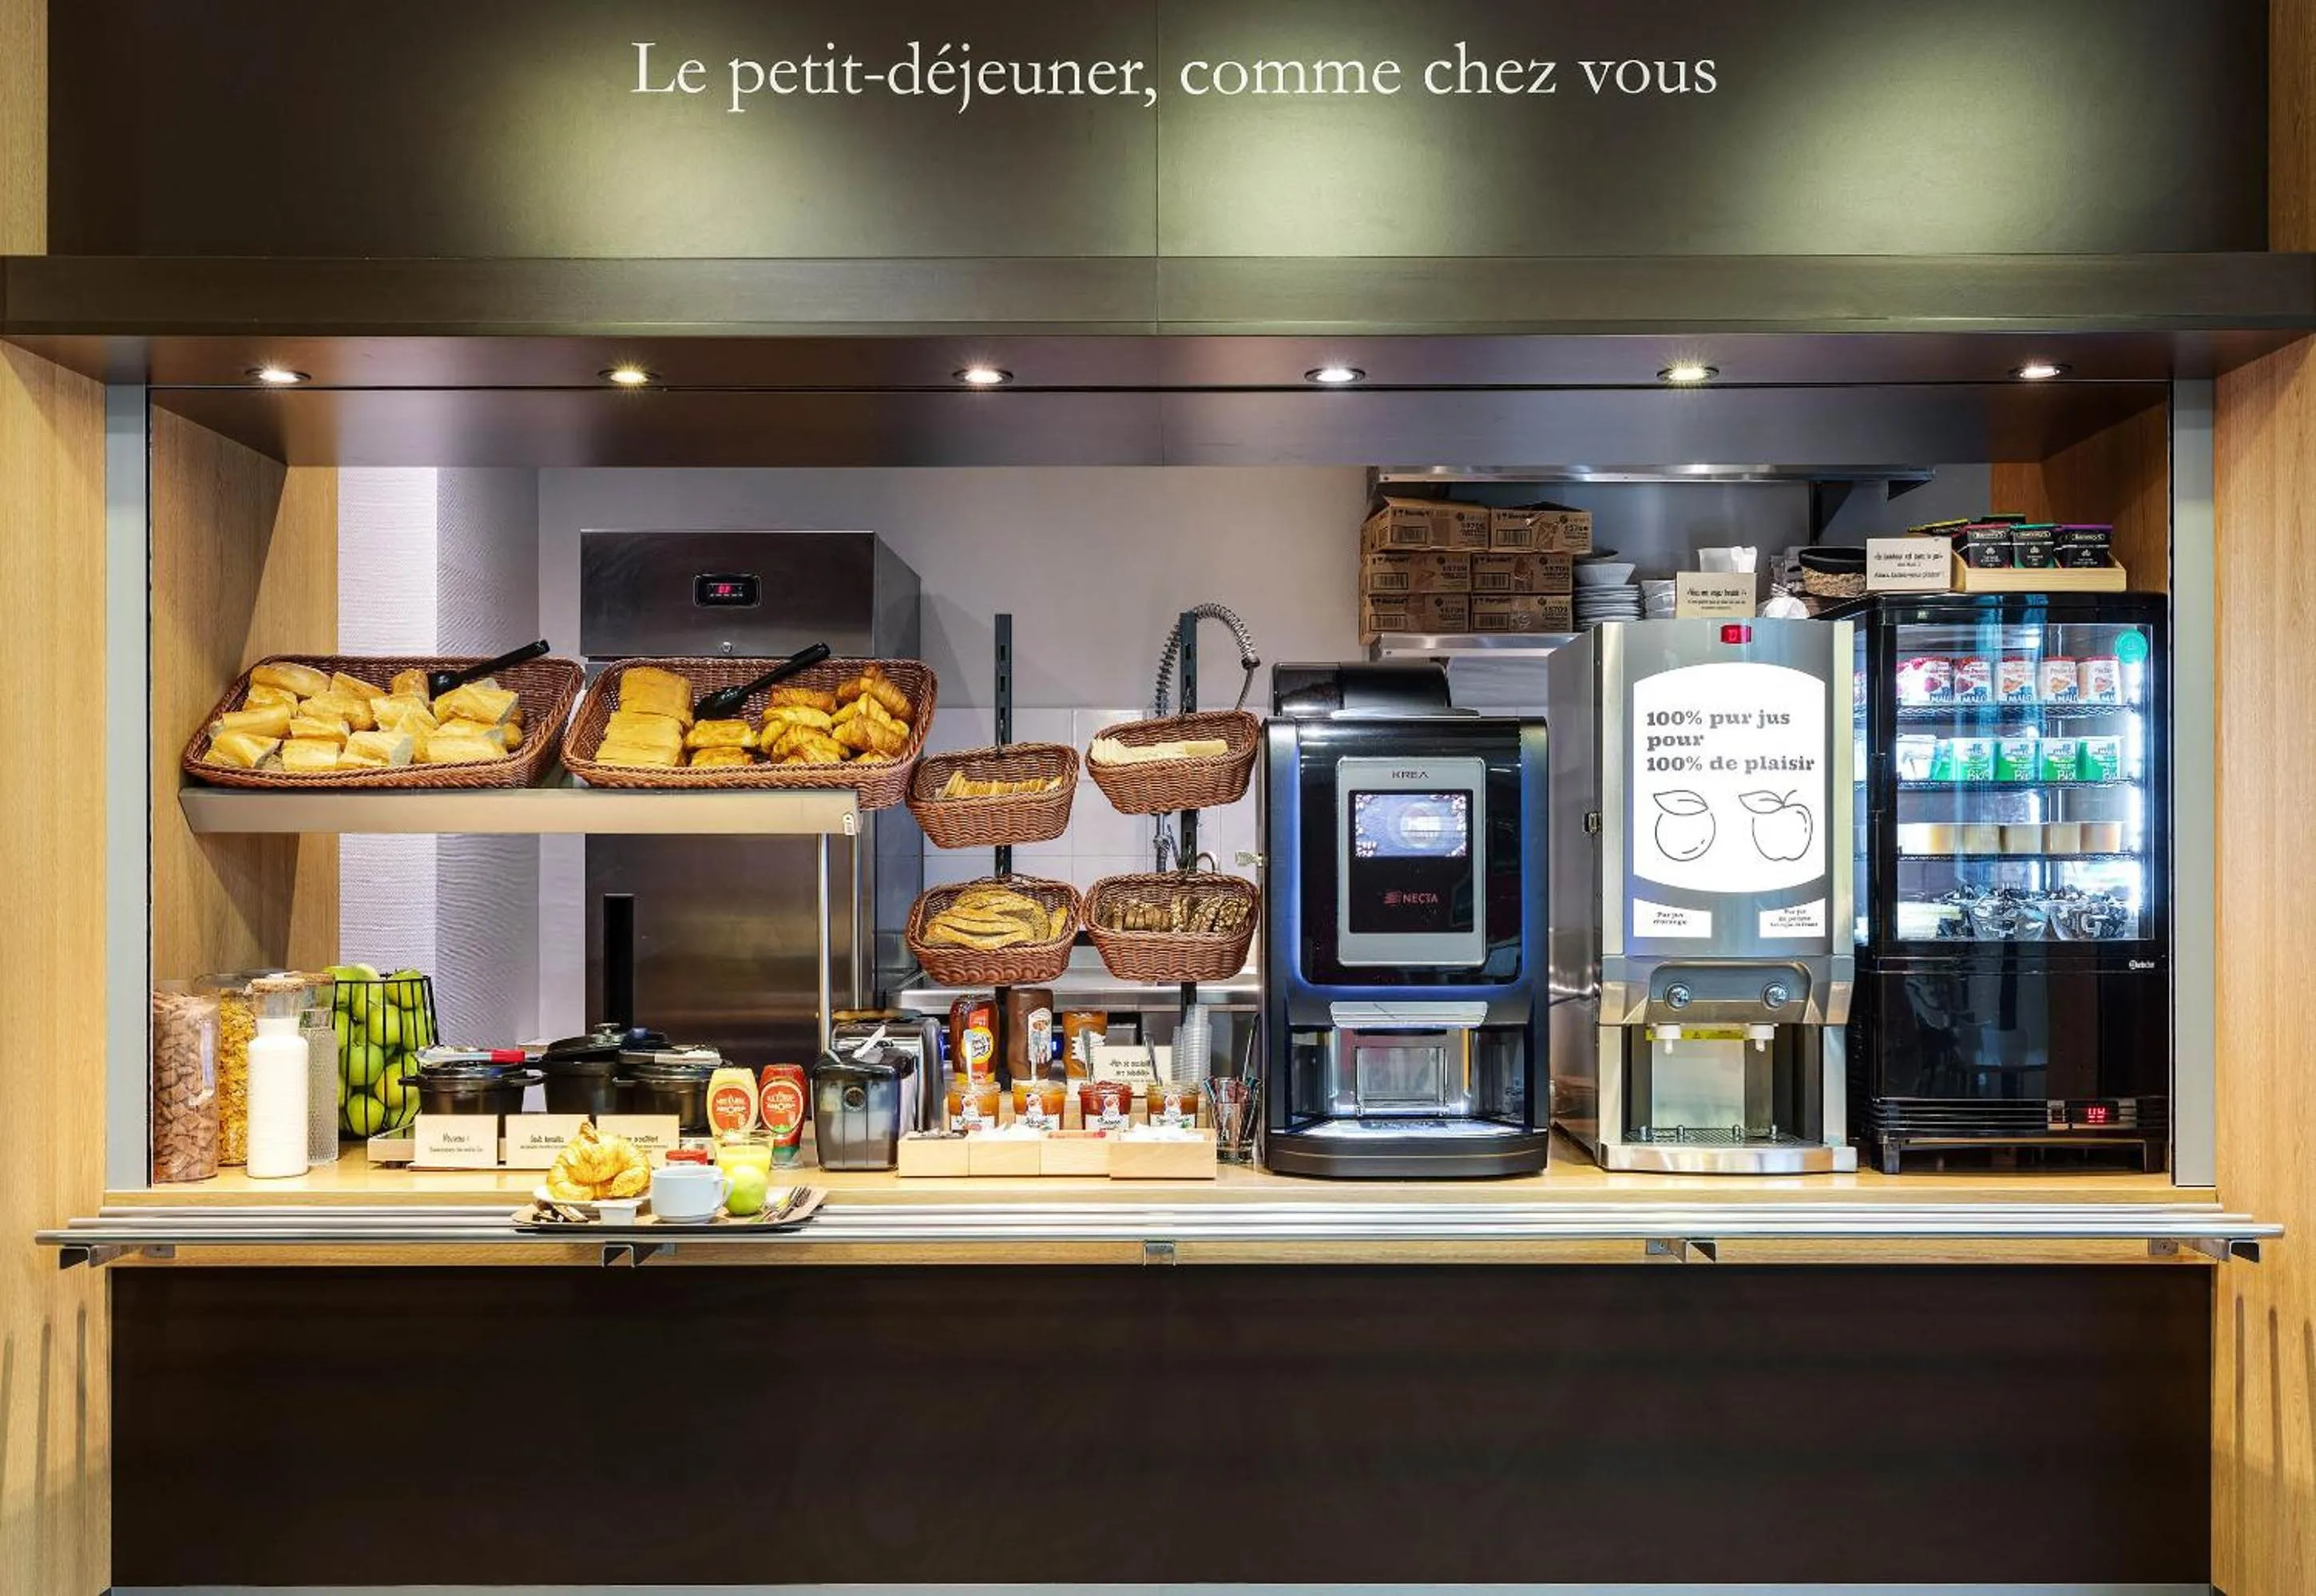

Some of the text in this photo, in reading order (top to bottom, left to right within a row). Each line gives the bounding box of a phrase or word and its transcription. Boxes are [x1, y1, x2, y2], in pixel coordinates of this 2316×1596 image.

[631, 42, 1716, 113] Le petit-déjeuner, comme chez vous
[1647, 709, 1791, 729] 100% pur jus
[1647, 735, 1704, 751] pour
[1647, 755, 1815, 774] 100% de plaisir
[1402, 893, 1438, 904] NECTA
